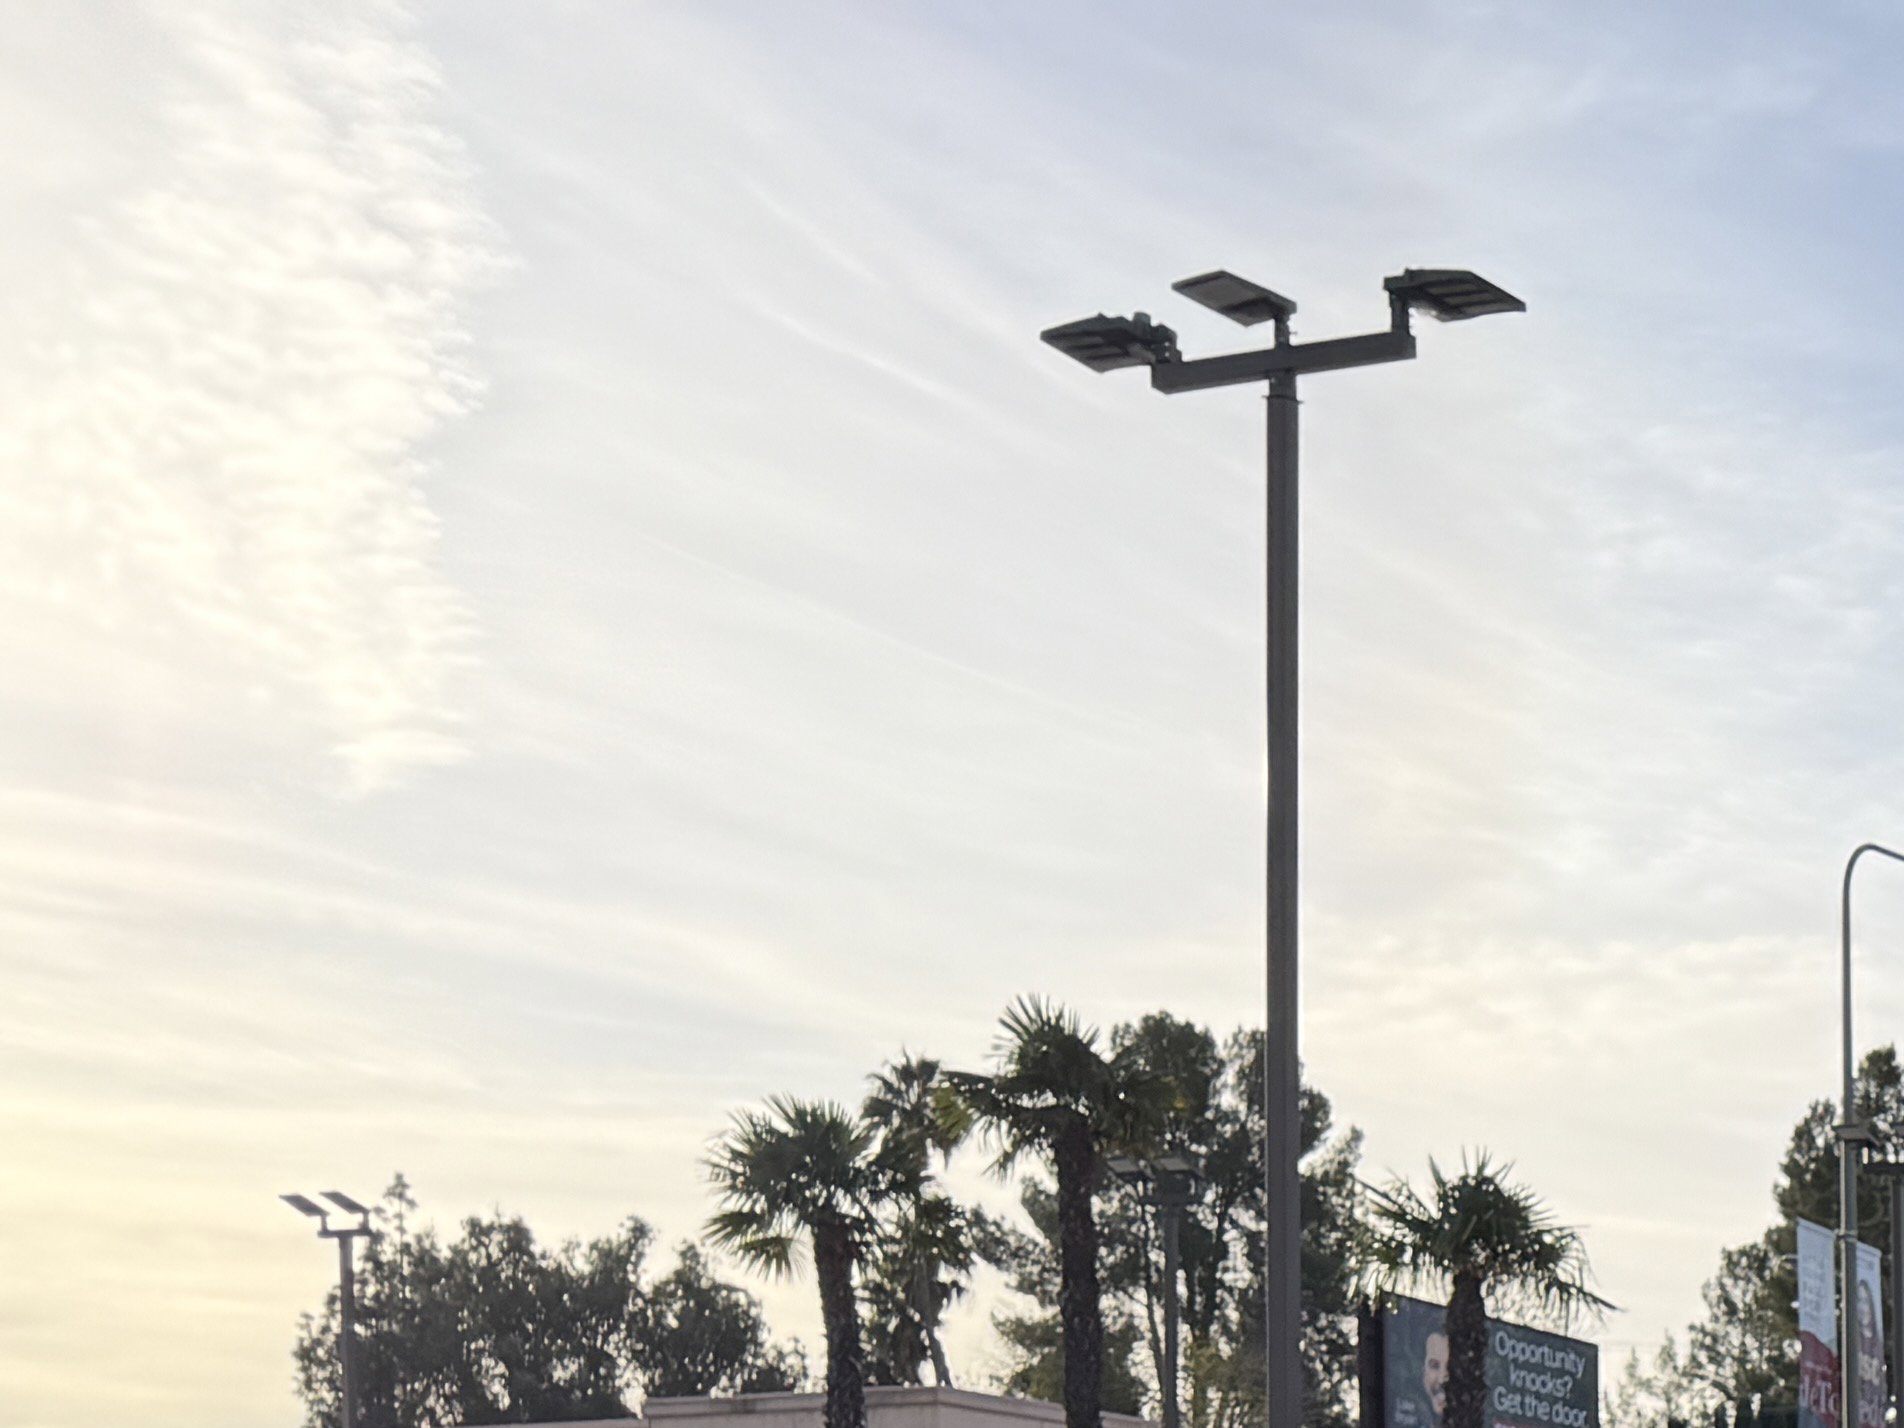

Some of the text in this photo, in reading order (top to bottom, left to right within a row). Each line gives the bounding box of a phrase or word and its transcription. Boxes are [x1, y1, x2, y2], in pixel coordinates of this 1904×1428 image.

[1495, 1331, 1586, 1379] Opportunity
[1509, 1363, 1573, 1399] knocks?
[1494, 1386, 1523, 1416] Get
[1524, 1392, 1550, 1421] the
